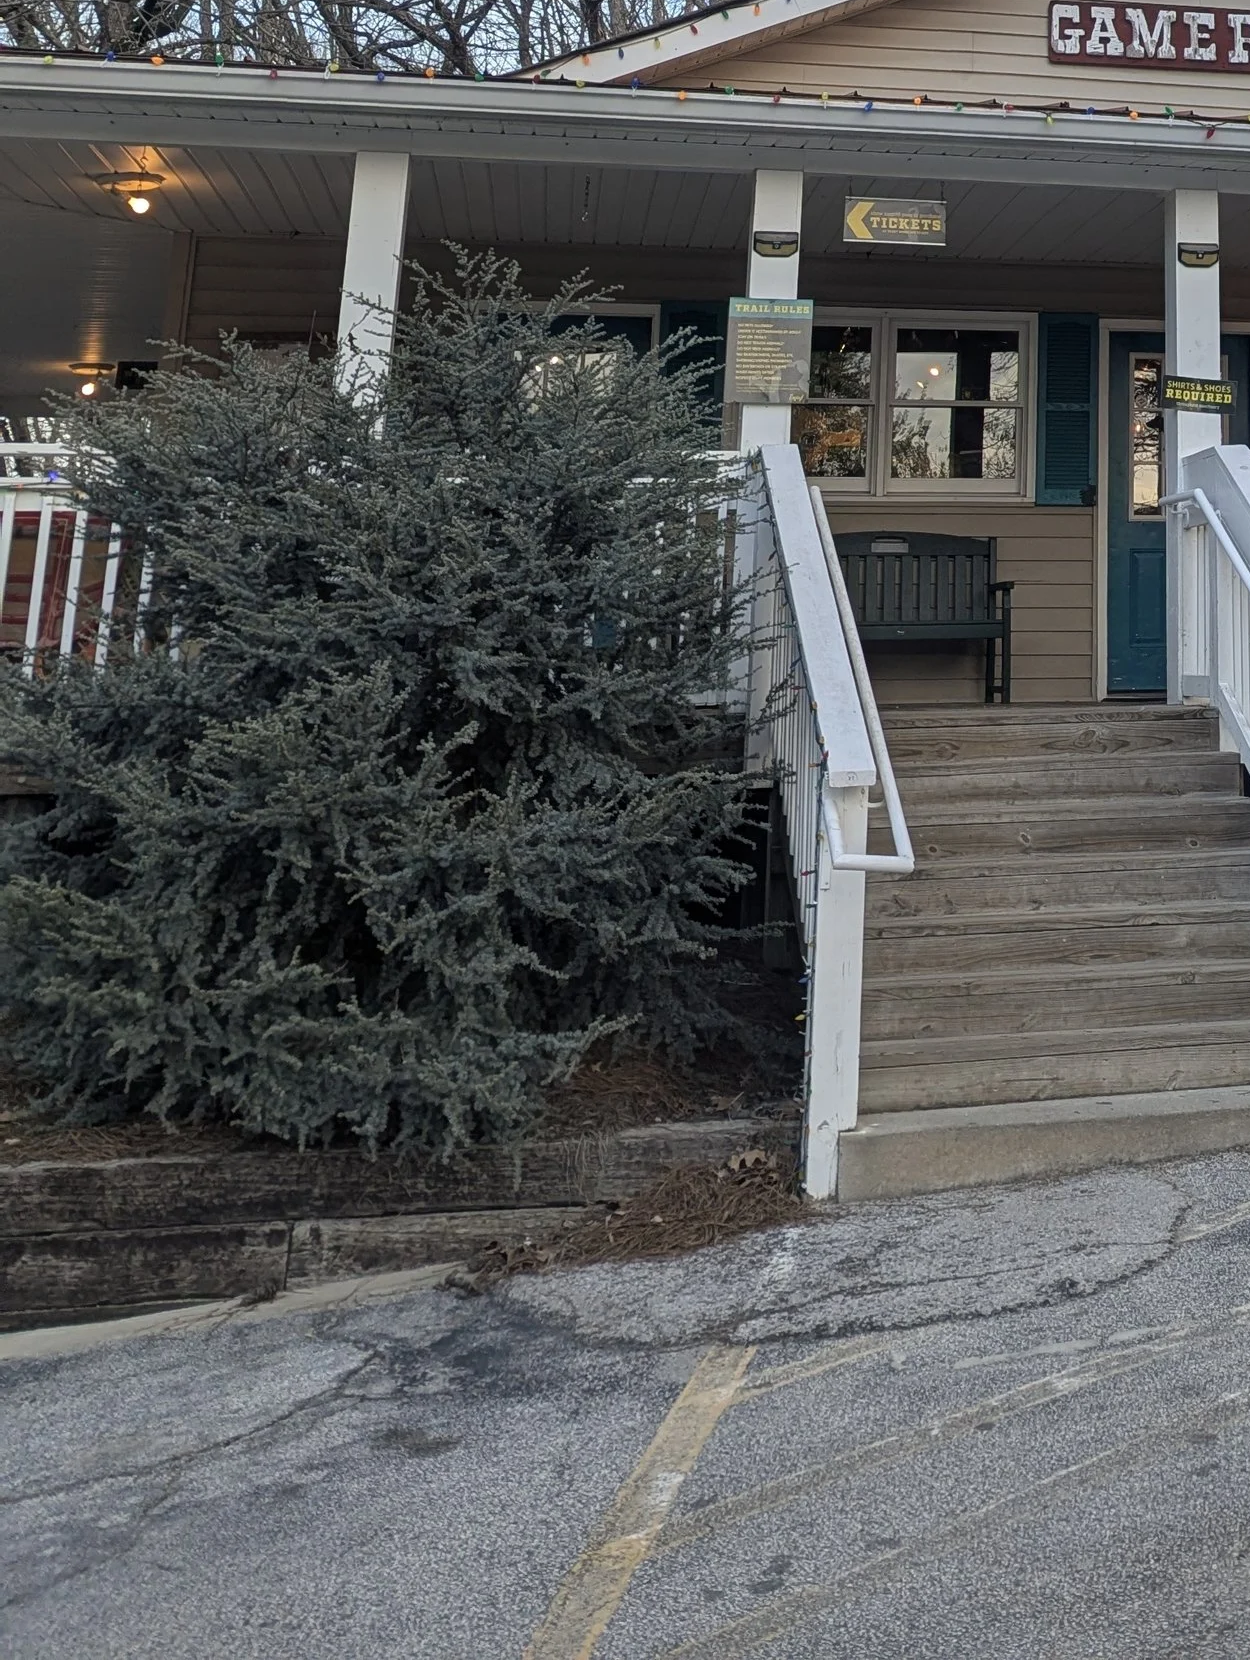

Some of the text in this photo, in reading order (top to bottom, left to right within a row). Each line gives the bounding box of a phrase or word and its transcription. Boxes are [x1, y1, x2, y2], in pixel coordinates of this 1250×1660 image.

[1051, 4, 1217, 61] GAME
[870, 217, 941, 231] TICKETS
[735, 304, 810, 314] TRAIL RULES
[1167, 380, 1231, 393] SHIRTS & SHOES
[1165, 388, 1232, 404] REQUIRED
